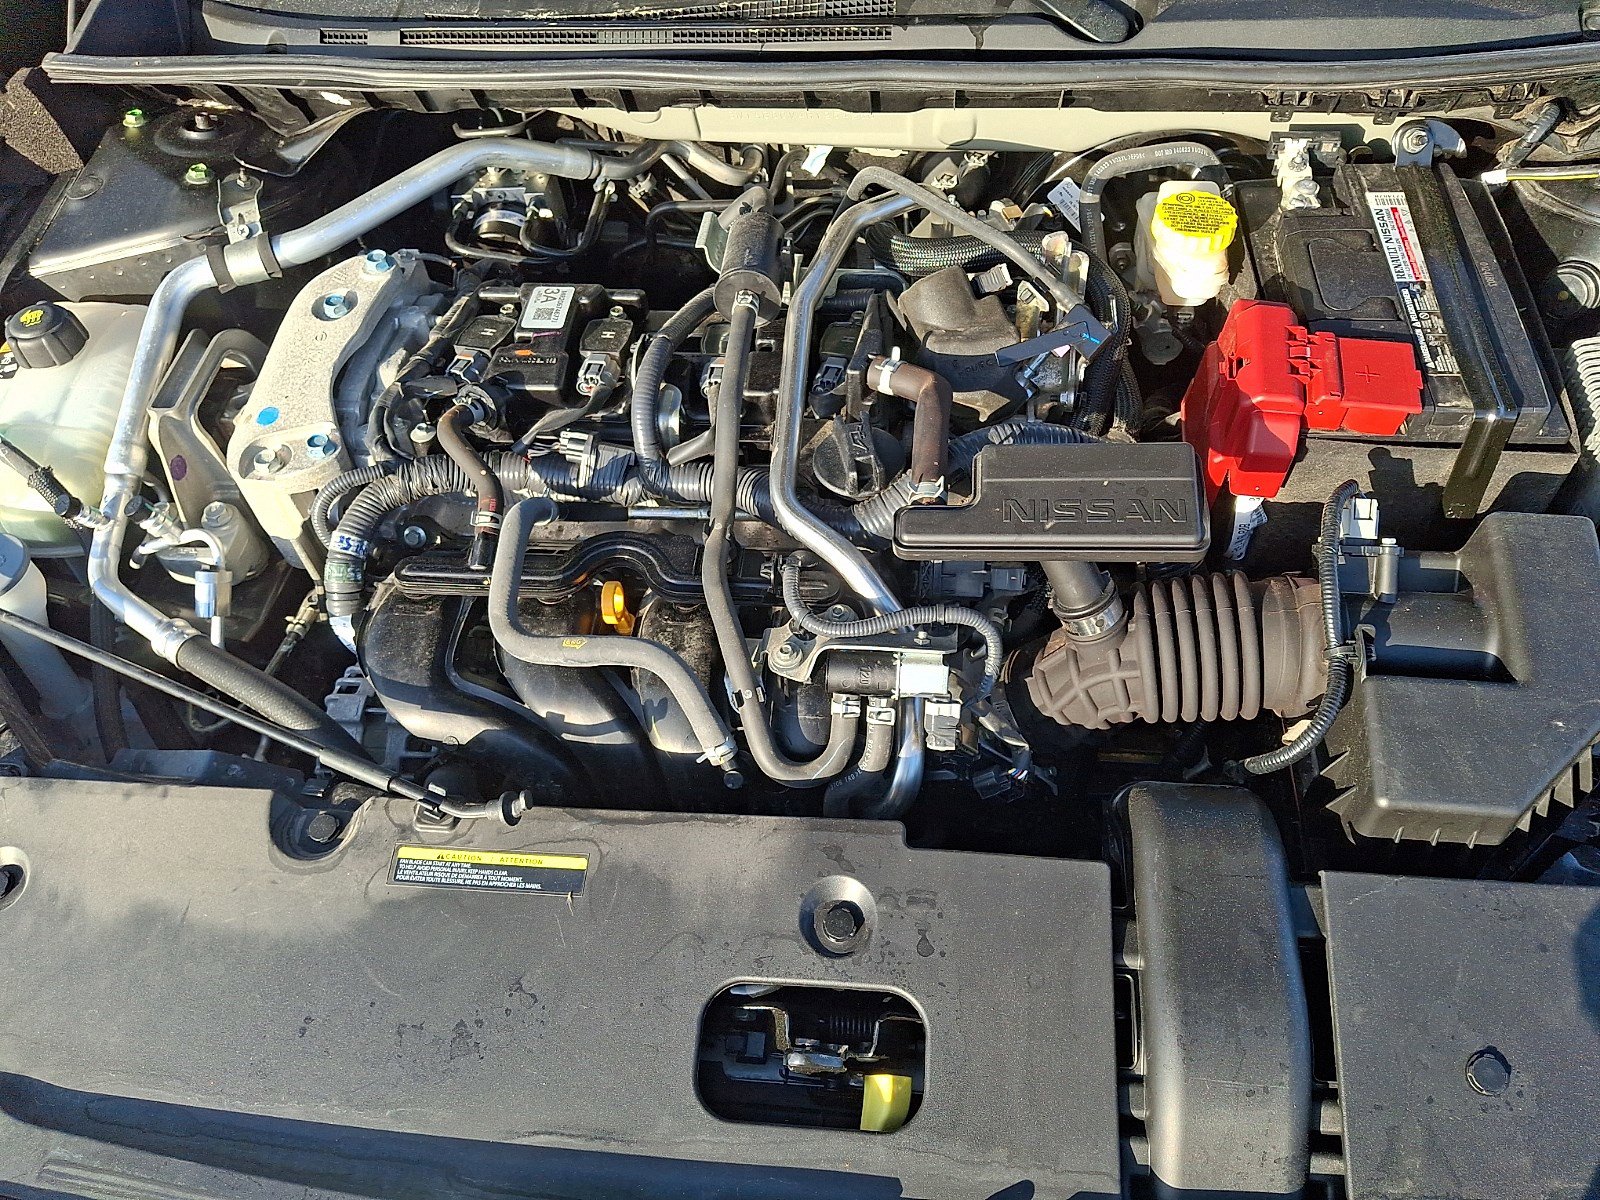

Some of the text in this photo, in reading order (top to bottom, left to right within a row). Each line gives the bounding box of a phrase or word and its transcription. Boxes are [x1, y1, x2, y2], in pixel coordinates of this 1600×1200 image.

[1374, 208, 1395, 244] NISSAN
[1387, 246, 1406, 280] RENAULT
[540, 288, 560, 303] 3A
[1002, 499, 1187, 522] NISSAN
[445, 853, 482, 861] CAUTION
[499, 856, 543, 865] ATTENTION
